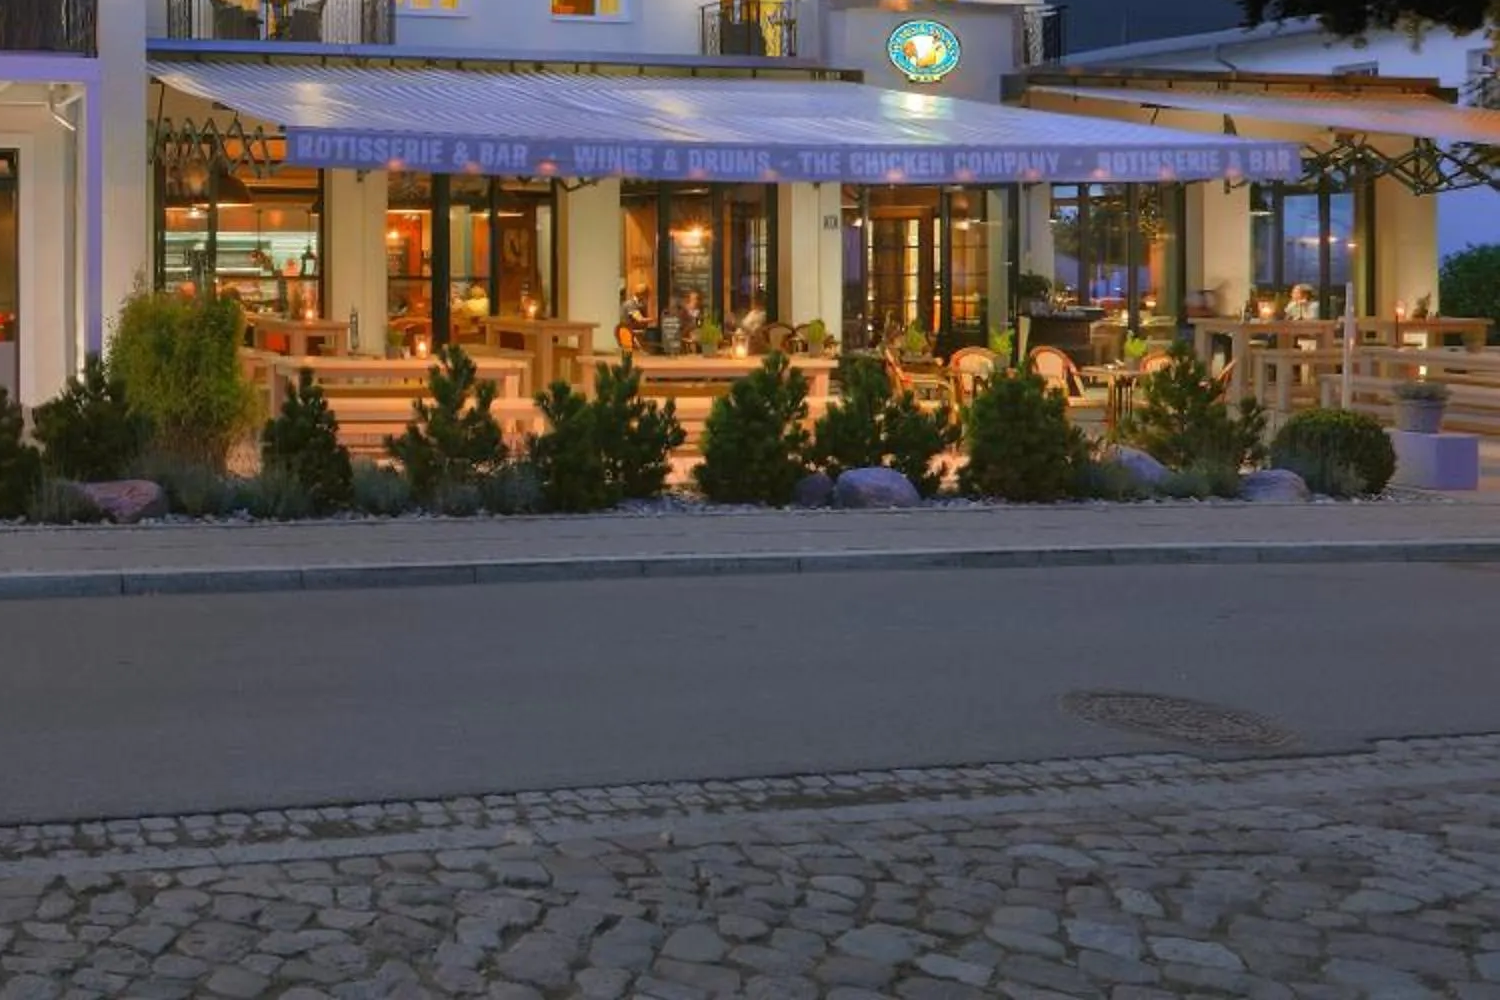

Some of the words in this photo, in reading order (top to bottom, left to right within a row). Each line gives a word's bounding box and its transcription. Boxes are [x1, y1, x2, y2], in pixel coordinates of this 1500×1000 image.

[296, 133, 444, 165] ROTISSERIE
[453, 141, 470, 166] &
[480, 143, 529, 168] BAR
[572, 145, 654, 172] WINGS
[662, 148, 678, 172] &
[687, 148, 771, 174] DRUMS
[800, 151, 842, 174] THE
[849, 151, 945, 175] CHICKEN
[953, 151, 1061, 175] COMPANY
[1097, 150, 1222, 174] ROTISSERIE
[1249, 149, 1292, 172] BAR
